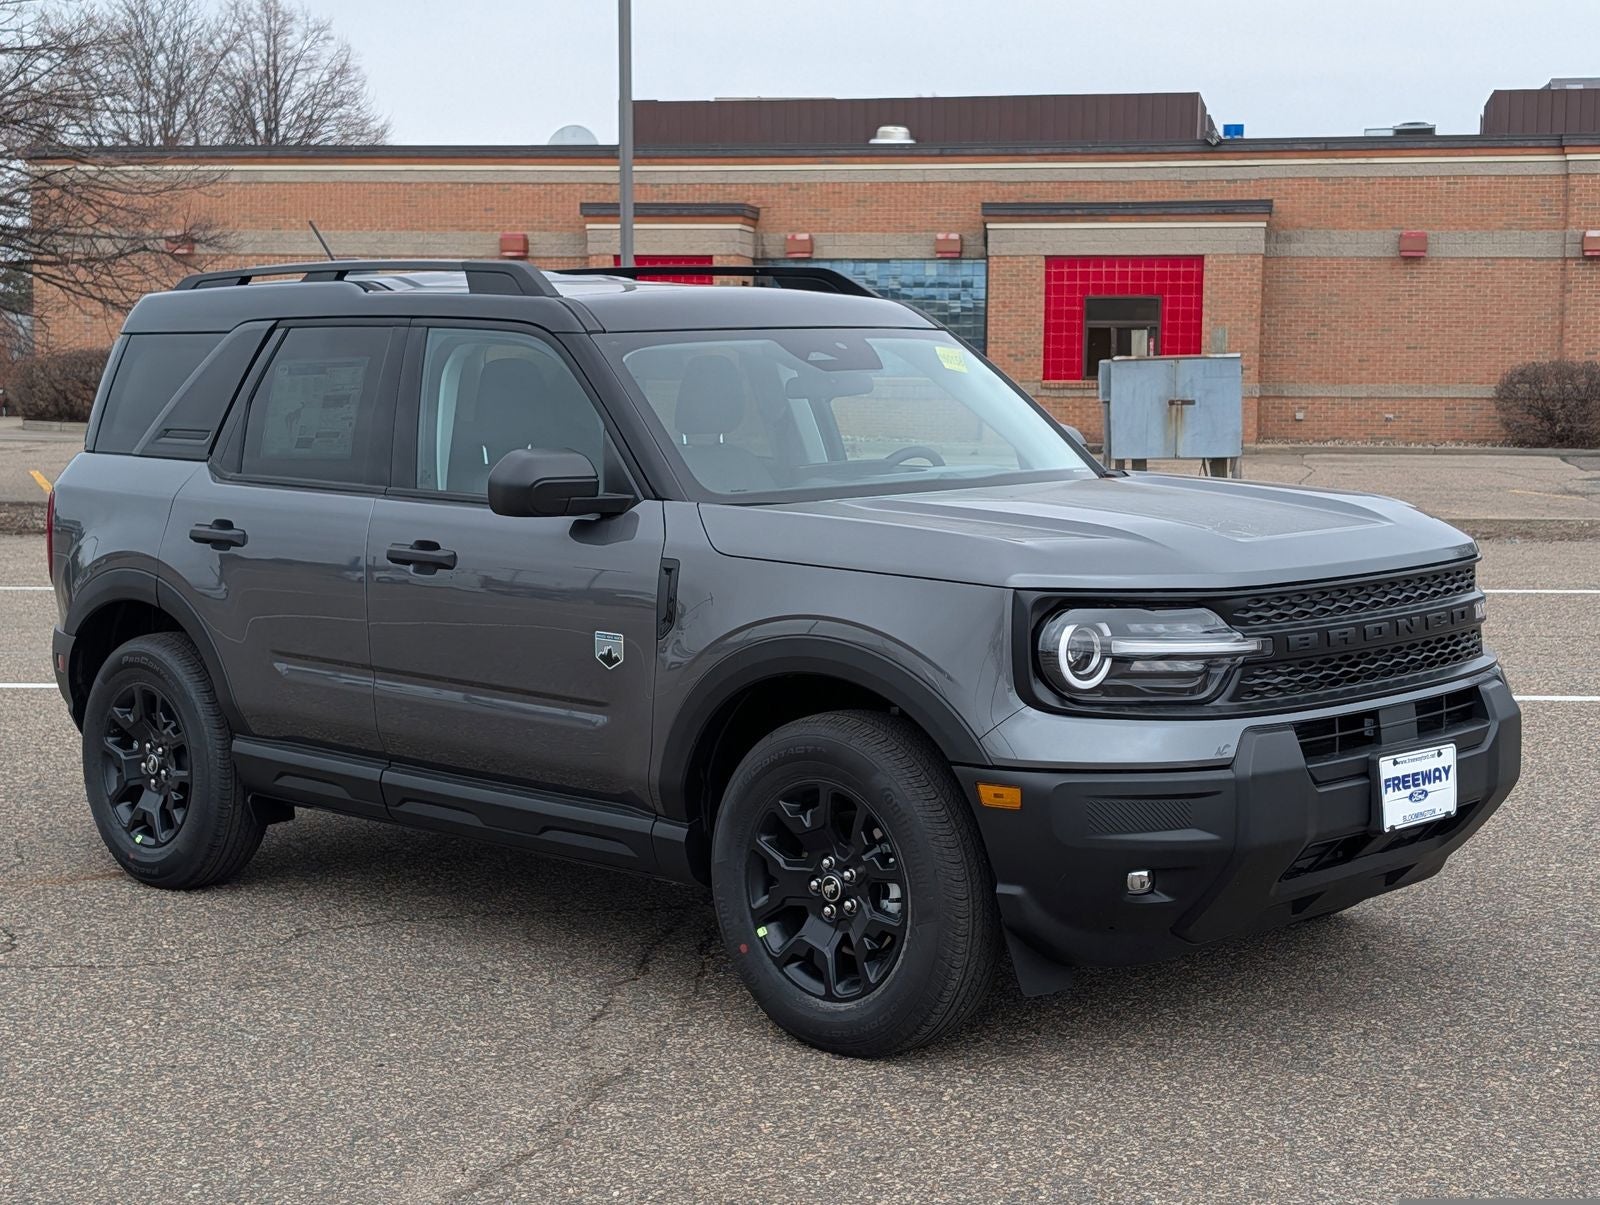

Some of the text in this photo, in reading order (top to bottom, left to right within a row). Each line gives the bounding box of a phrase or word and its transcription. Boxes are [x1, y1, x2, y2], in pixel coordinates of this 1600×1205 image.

[1287, 606, 1469, 652] BRONCO
[1384, 765, 1452, 794] FREEWAY
[1402, 808, 1436, 822] BLOOMINGTON
